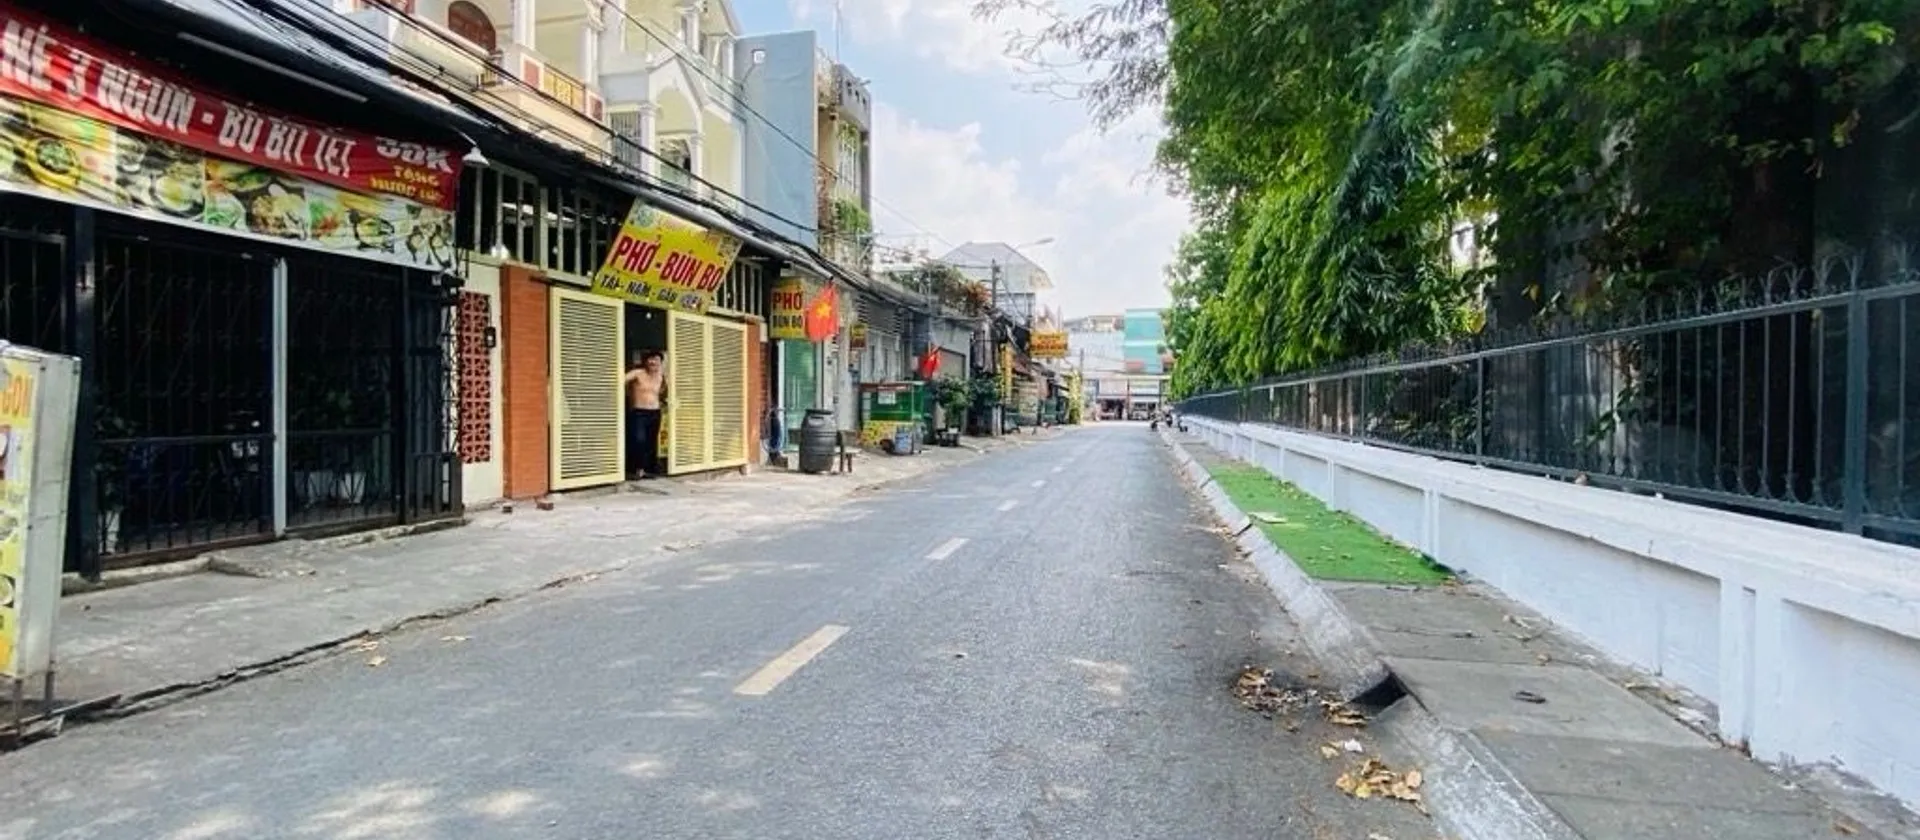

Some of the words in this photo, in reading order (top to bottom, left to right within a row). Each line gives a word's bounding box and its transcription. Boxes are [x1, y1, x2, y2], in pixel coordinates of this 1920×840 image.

[610, 233, 662, 275] PHỞ
[660, 249, 703, 287] BÚN
[772, 284, 804, 310] PHỞ
